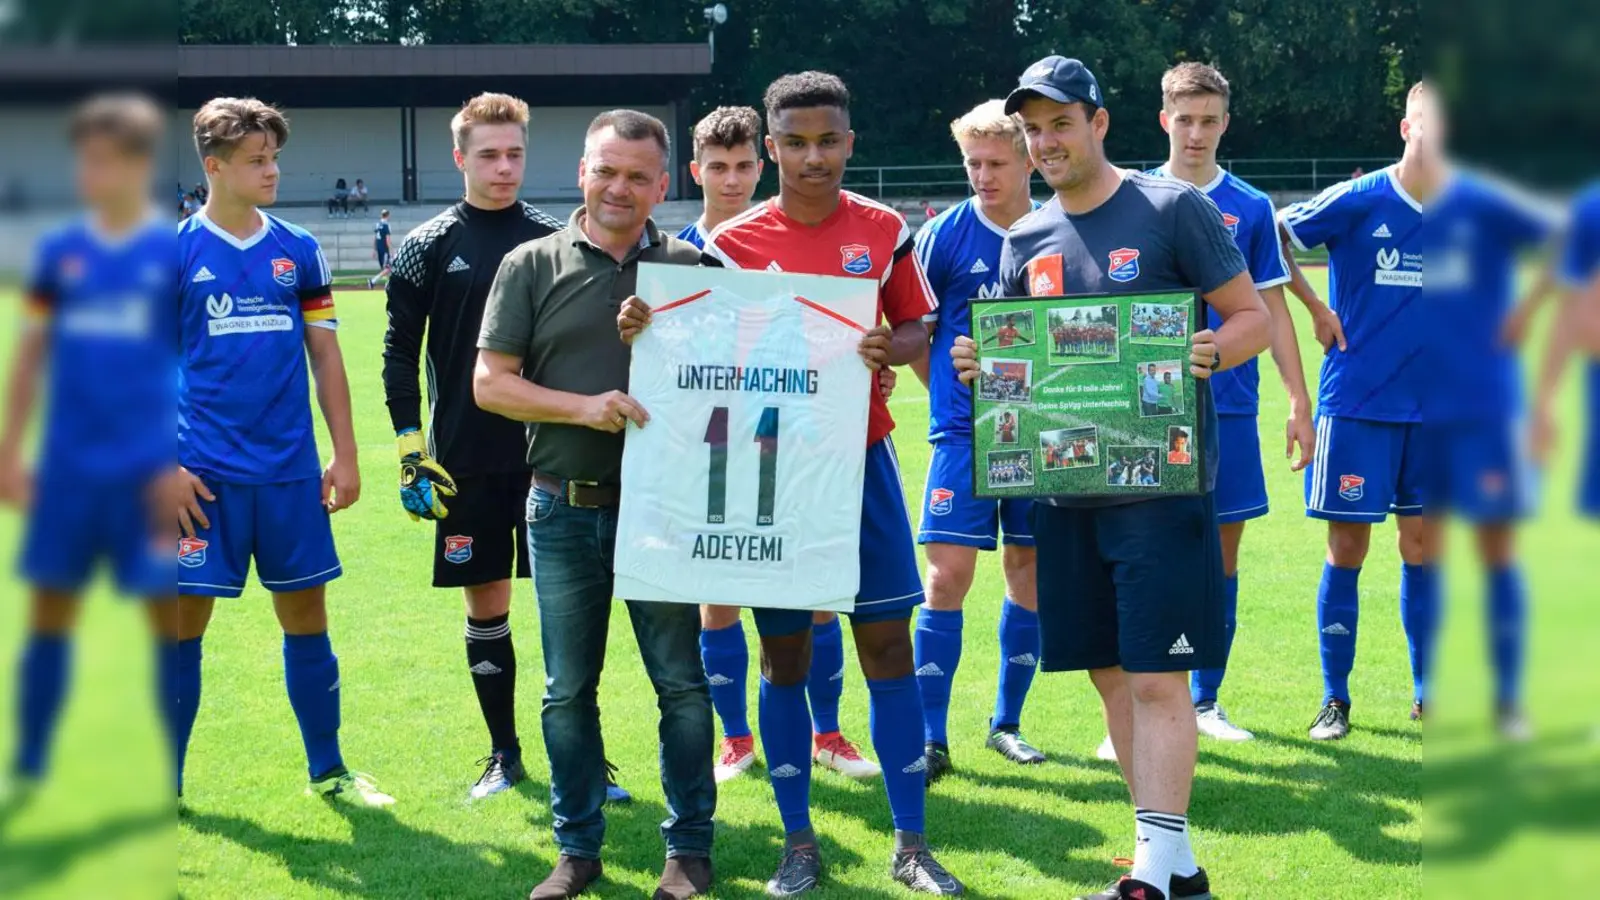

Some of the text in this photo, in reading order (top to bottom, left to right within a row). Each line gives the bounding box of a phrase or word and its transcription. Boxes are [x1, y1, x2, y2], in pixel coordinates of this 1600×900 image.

[215, 321, 252, 330] WAGNER
[678, 365, 818, 394] UNTERHACHING
[704, 407, 779, 525] 11
[692, 534, 782, 562] ADEYEMI
[1168, 647, 1194, 655] adidas
